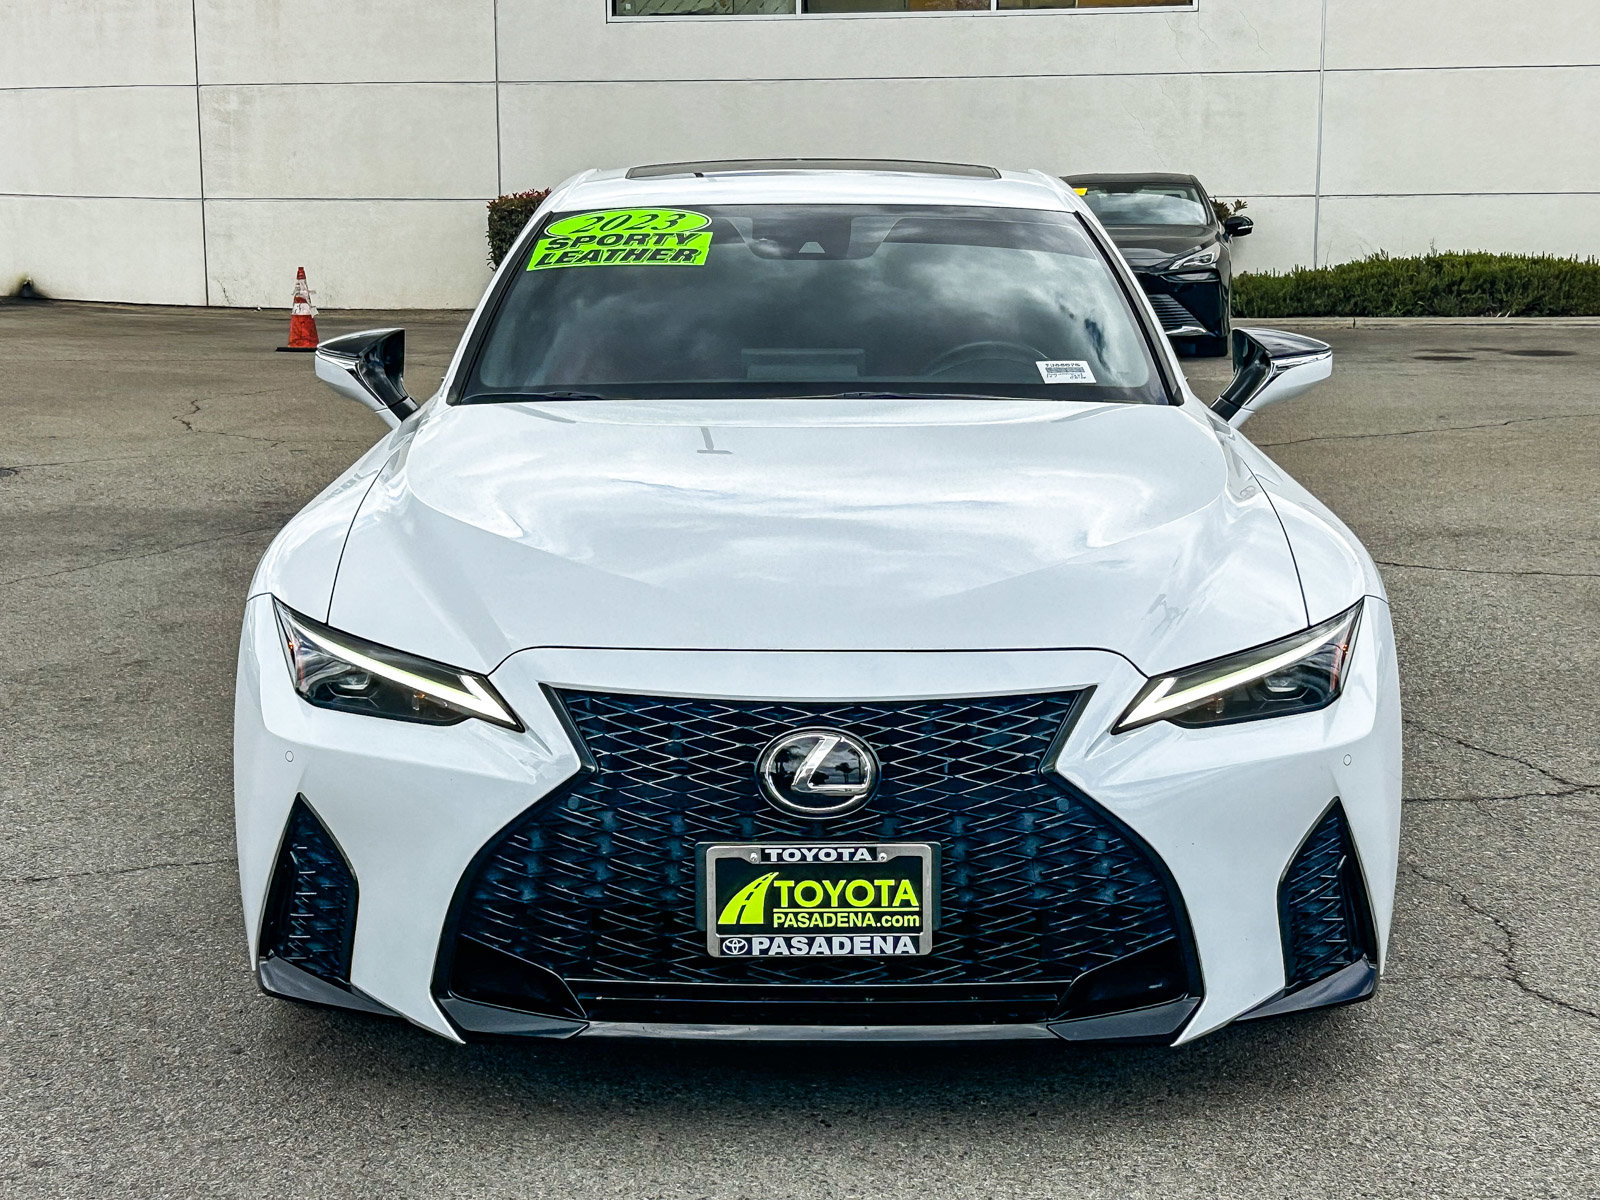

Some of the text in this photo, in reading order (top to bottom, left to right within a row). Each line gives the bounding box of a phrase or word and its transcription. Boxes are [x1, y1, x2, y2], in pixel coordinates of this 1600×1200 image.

[568, 213, 686, 234] 2023
[545, 233, 699, 250] SPORTY
[535, 248, 702, 268] LEATHER
[764, 848, 872, 862] TOYOTA
[773, 879, 919, 908] TOYOTA
[773, 913, 920, 928] PASADENA.com
[752, 936, 917, 955] PASADENA
